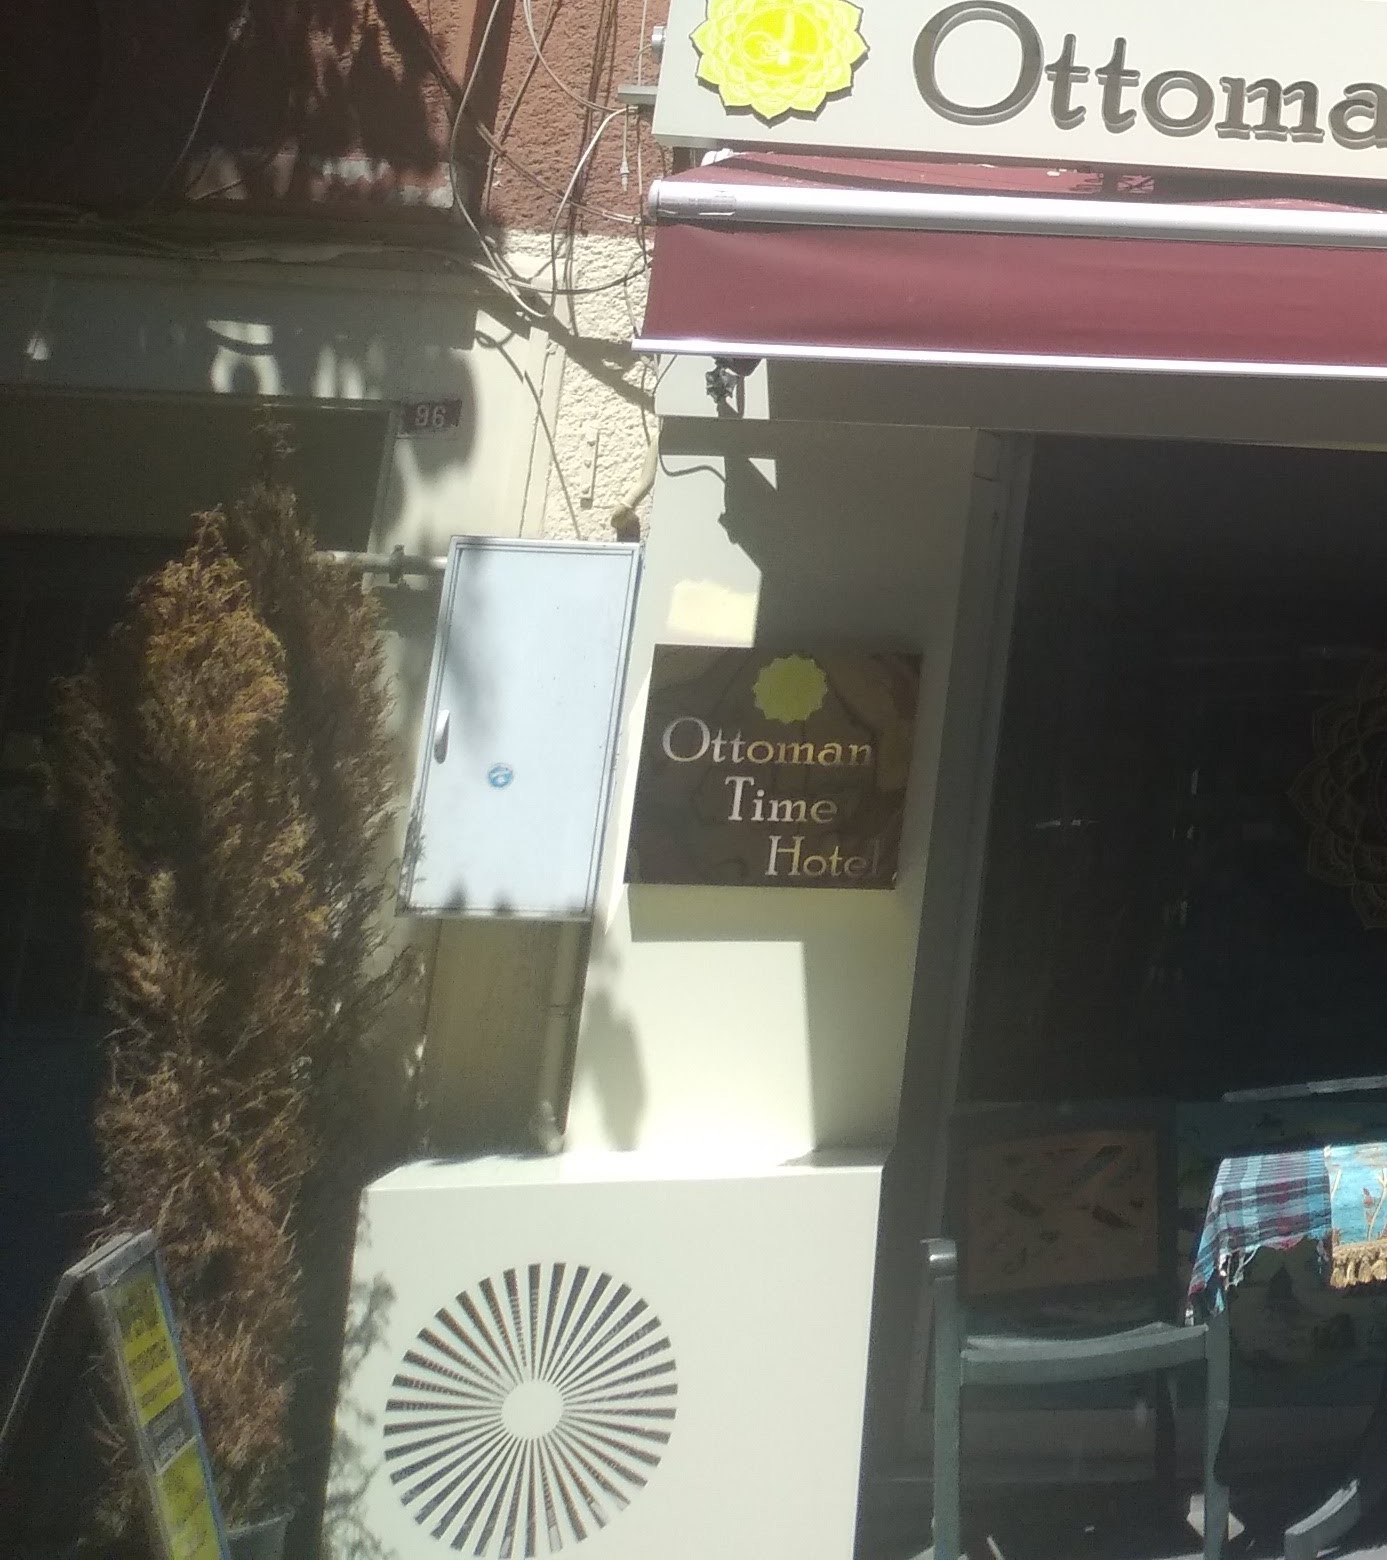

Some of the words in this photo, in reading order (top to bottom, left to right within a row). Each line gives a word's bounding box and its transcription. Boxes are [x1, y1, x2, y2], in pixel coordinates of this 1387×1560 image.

[415, 404, 447, 429] 96
[661, 715, 874, 766] Ottoman
[724, 775, 839, 824] Time
[764, 834, 881, 878] Hotel
